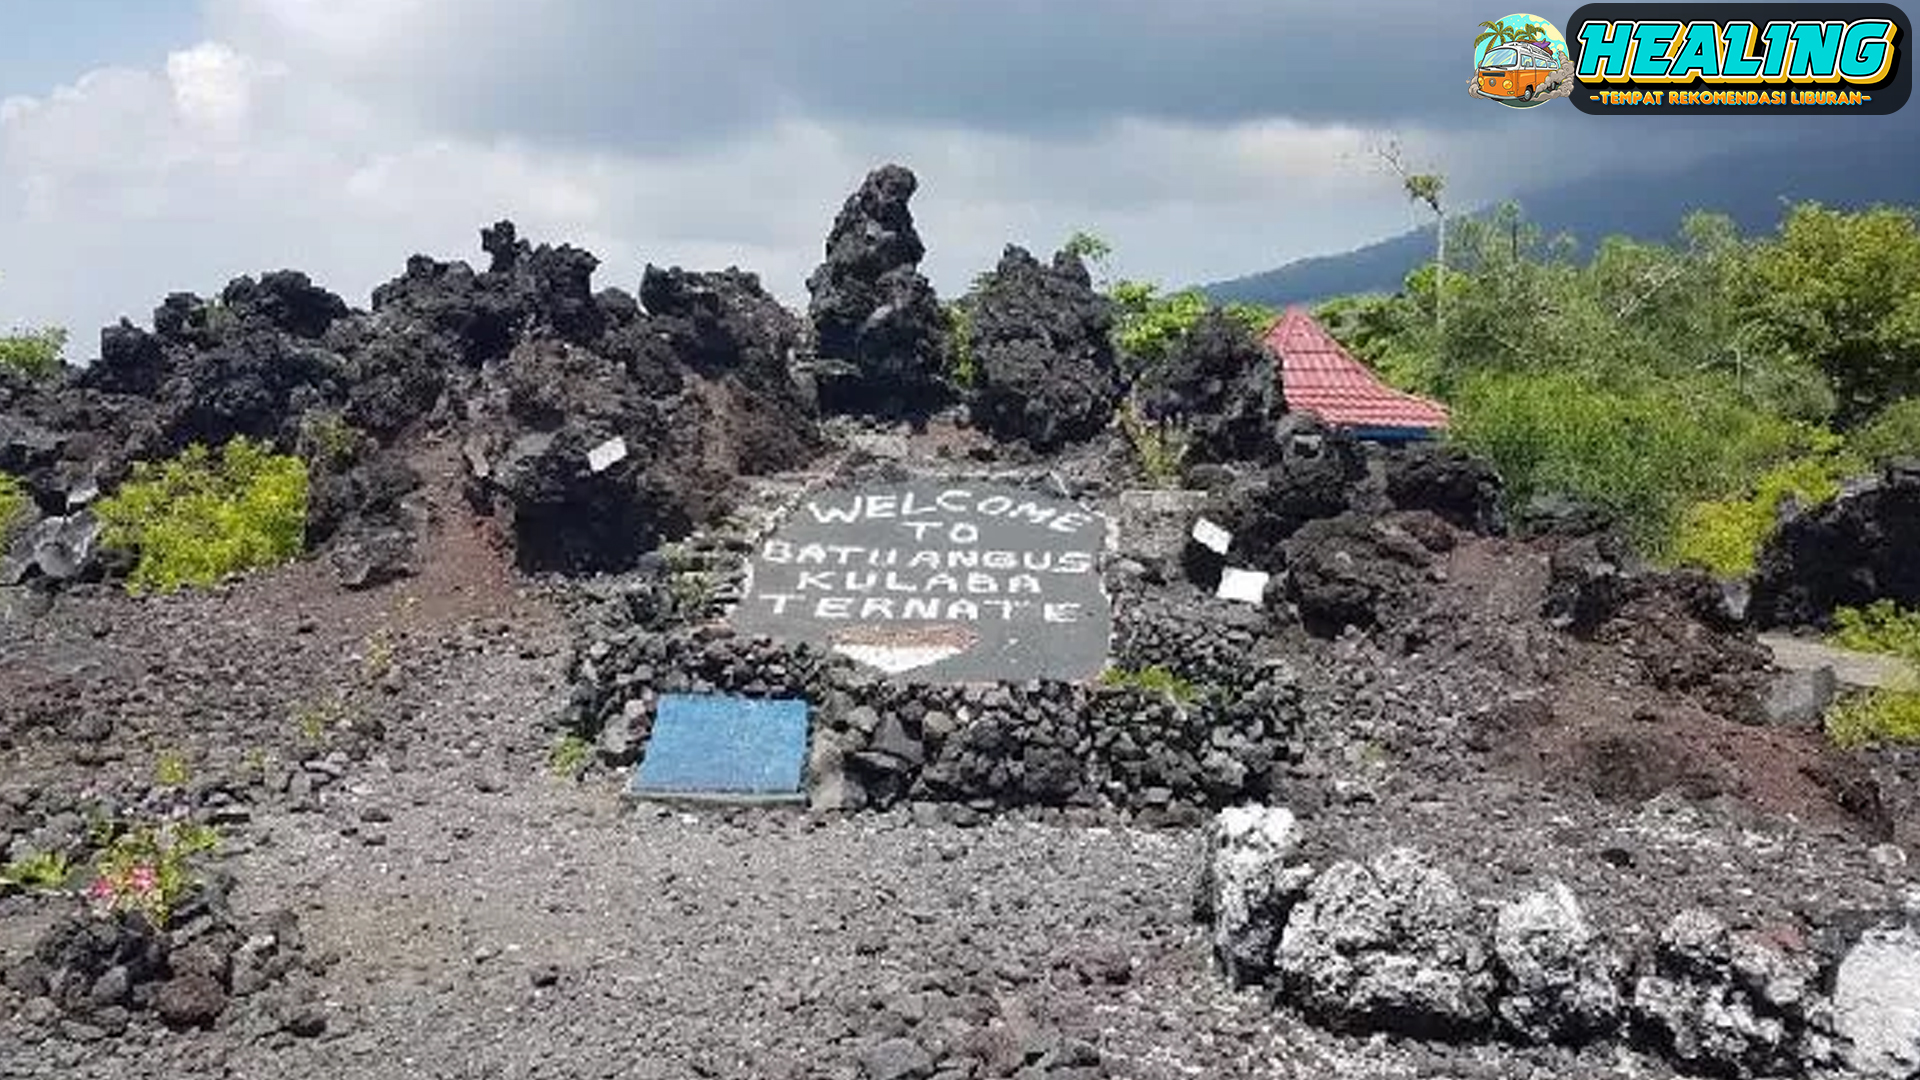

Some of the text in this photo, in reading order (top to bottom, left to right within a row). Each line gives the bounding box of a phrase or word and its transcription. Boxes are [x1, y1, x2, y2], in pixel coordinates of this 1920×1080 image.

[808, 490, 1092, 532] WELCOME
[902, 521, 978, 543] TO
[796, 571, 1041, 593] KULABA
[759, 594, 1082, 622] TERNATE
